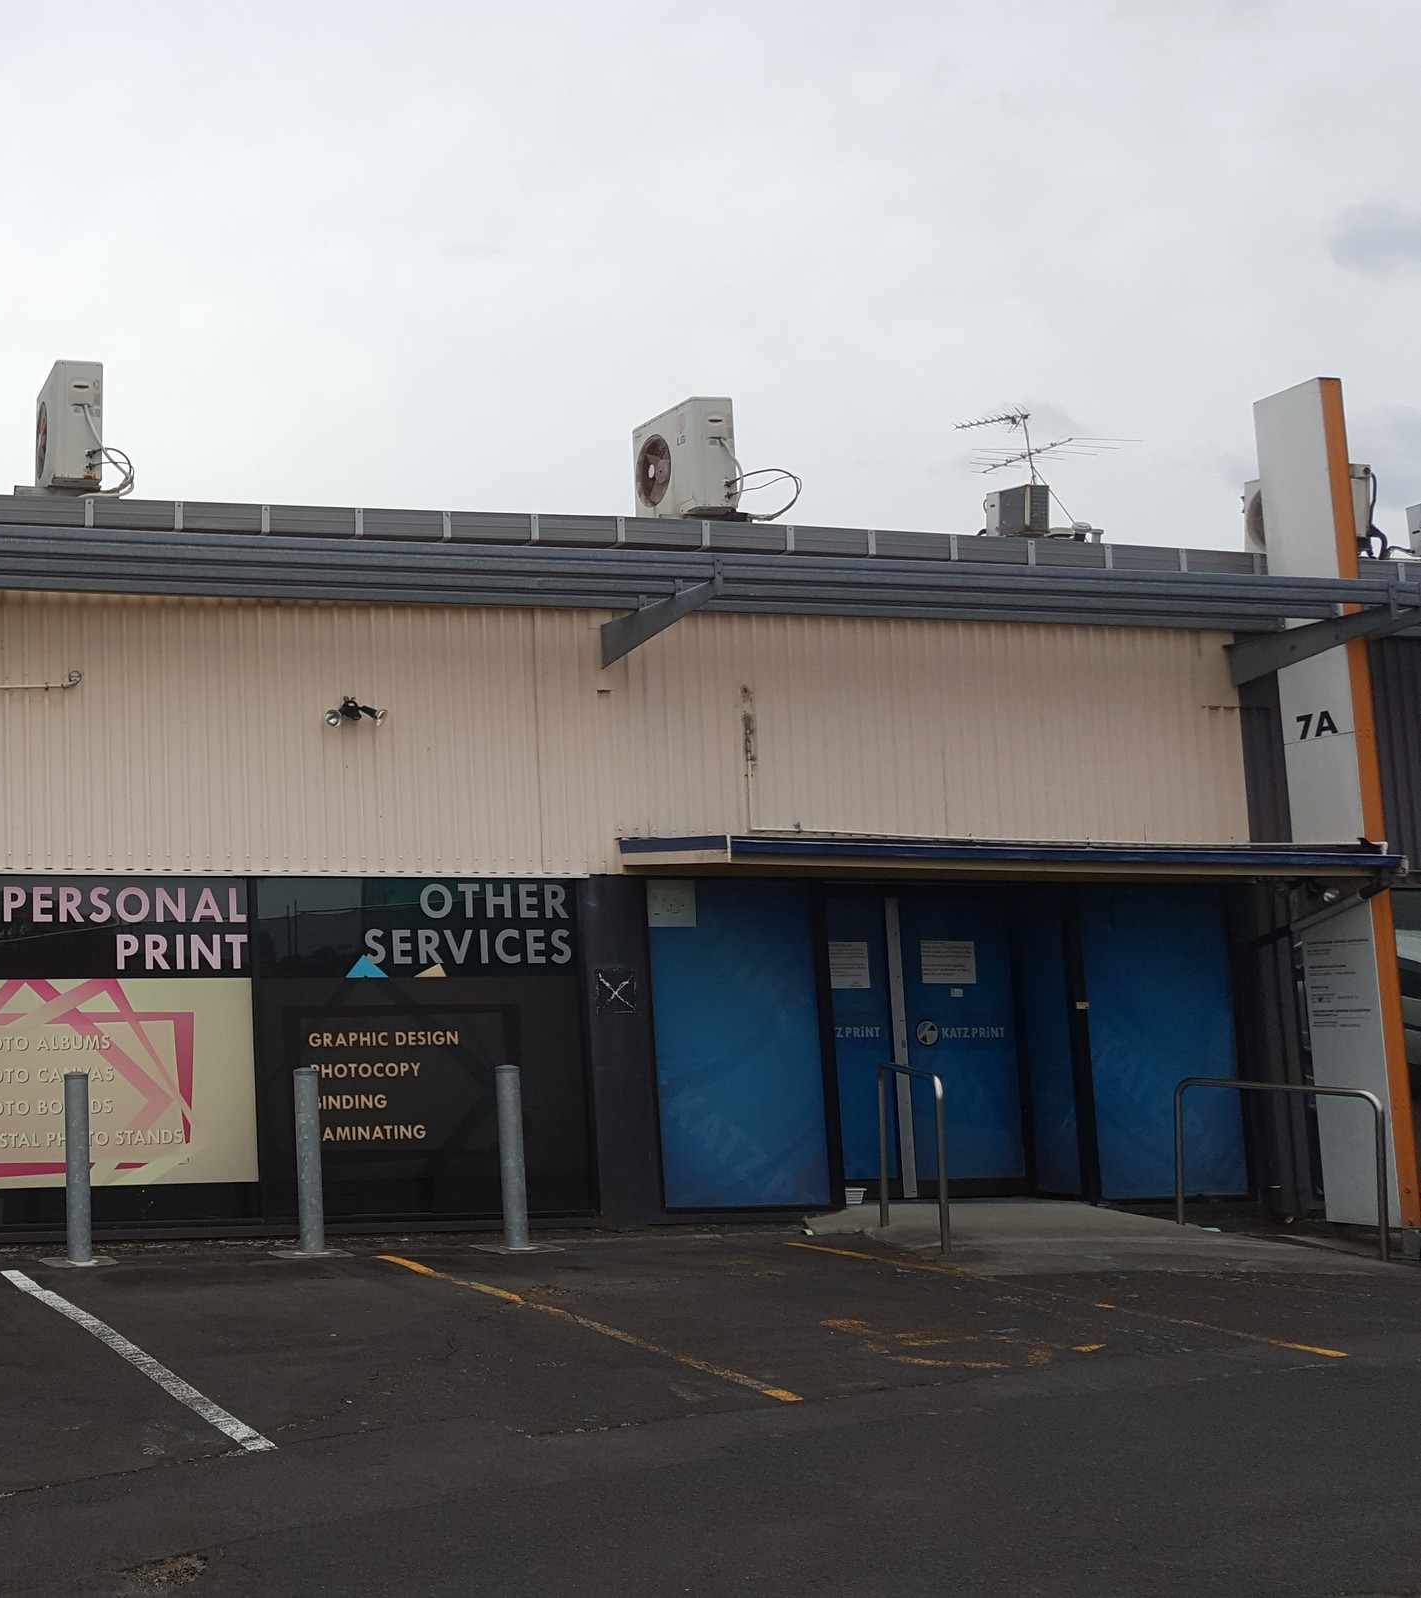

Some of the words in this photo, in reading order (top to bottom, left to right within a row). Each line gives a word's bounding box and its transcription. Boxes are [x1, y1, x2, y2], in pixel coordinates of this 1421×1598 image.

[676, 434, 686, 447] LG
[1295, 710, 1339, 740] 7A
[3, 886, 247, 923] PERSONAL
[419, 883, 570, 919] OTHER
[116, 934, 248, 970] PRINT
[364, 928, 572, 965] SERVICES
[308, 1032, 389, 1047] GRAPHIC
[395, 1031, 460, 1046] DESIGN
[941, 1027, 970, 1038] KATZ
[37, 1035, 113, 1051] ALBUMS
[37, 1067, 115, 1084] CAAS
[37, 1099, 114, 1116] BODS
[317, 1094, 388, 1110] INDING
[47, 1131, 110, 1148] PHTO
[115, 1129, 185, 1147] STANDS
[320, 1124, 427, 1142] AMINATING
